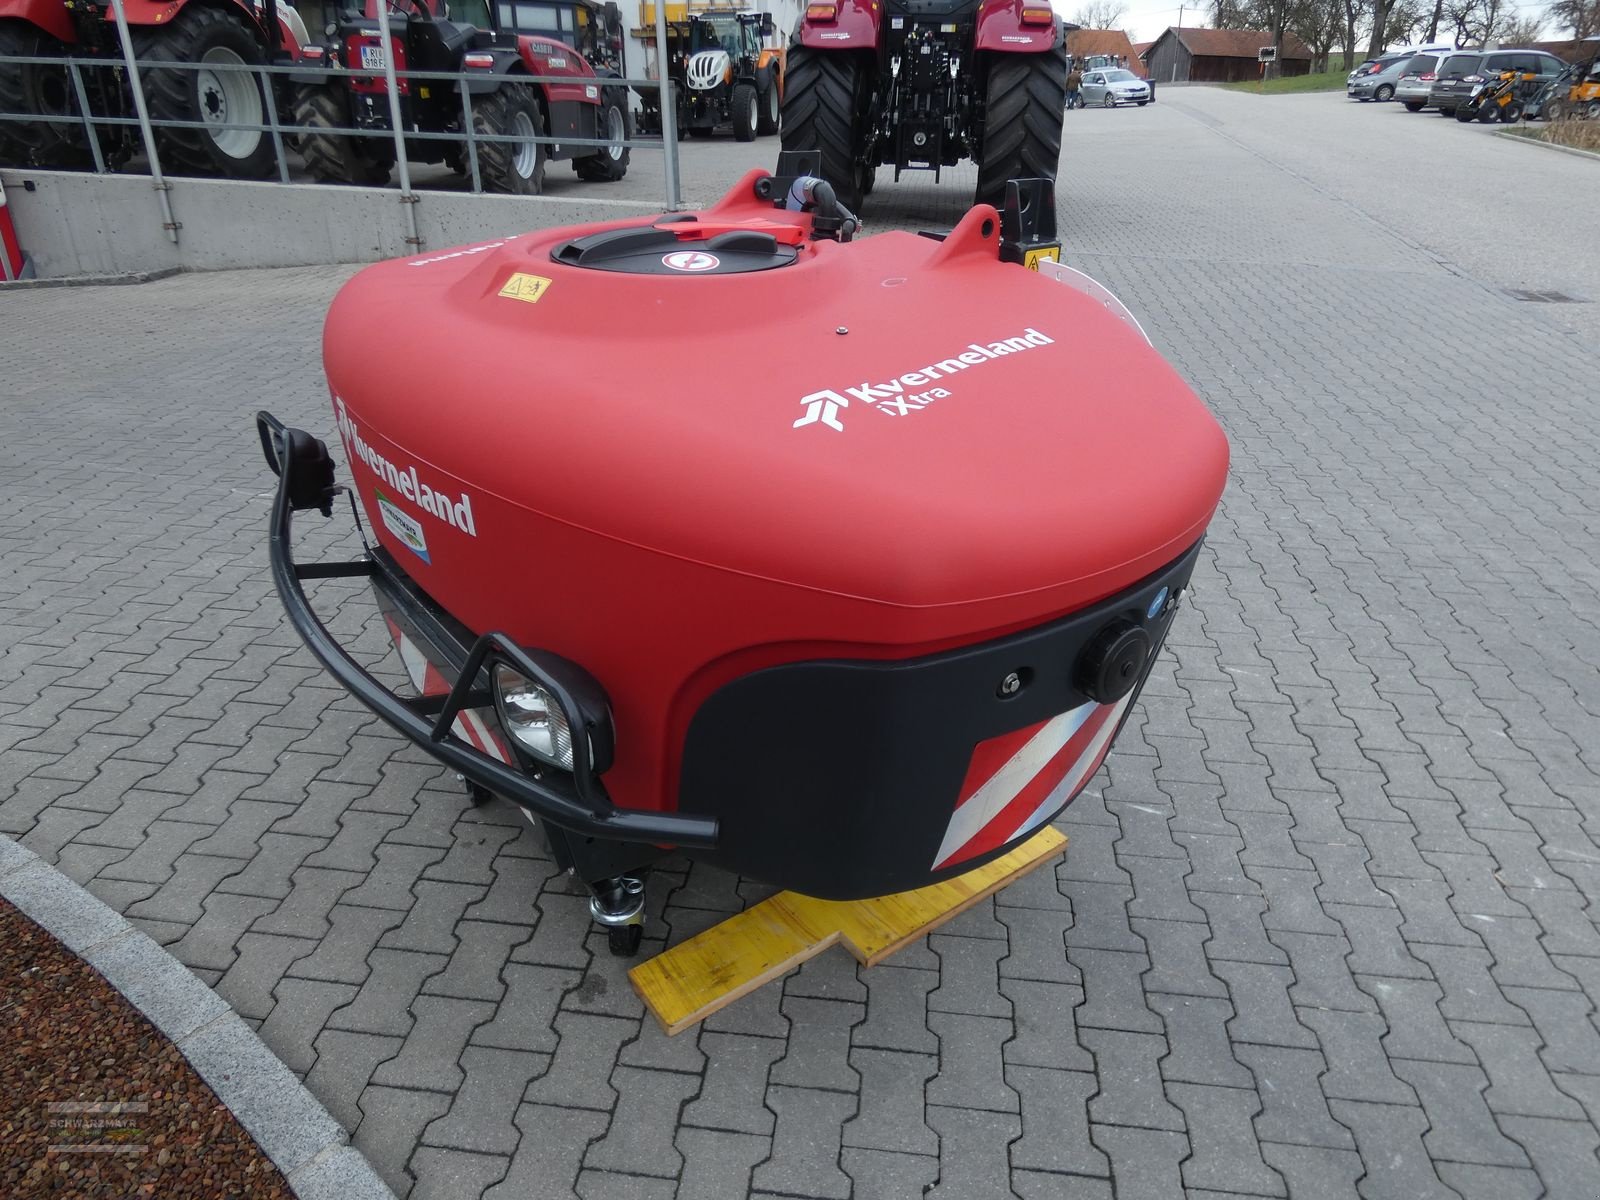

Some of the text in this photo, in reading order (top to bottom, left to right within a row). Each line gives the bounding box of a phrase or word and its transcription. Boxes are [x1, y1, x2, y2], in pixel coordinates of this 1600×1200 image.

[365, 58, 386, 67] 918F
[845, 328, 1055, 403] Kverneland
[876, 387, 952, 416] iXtra
